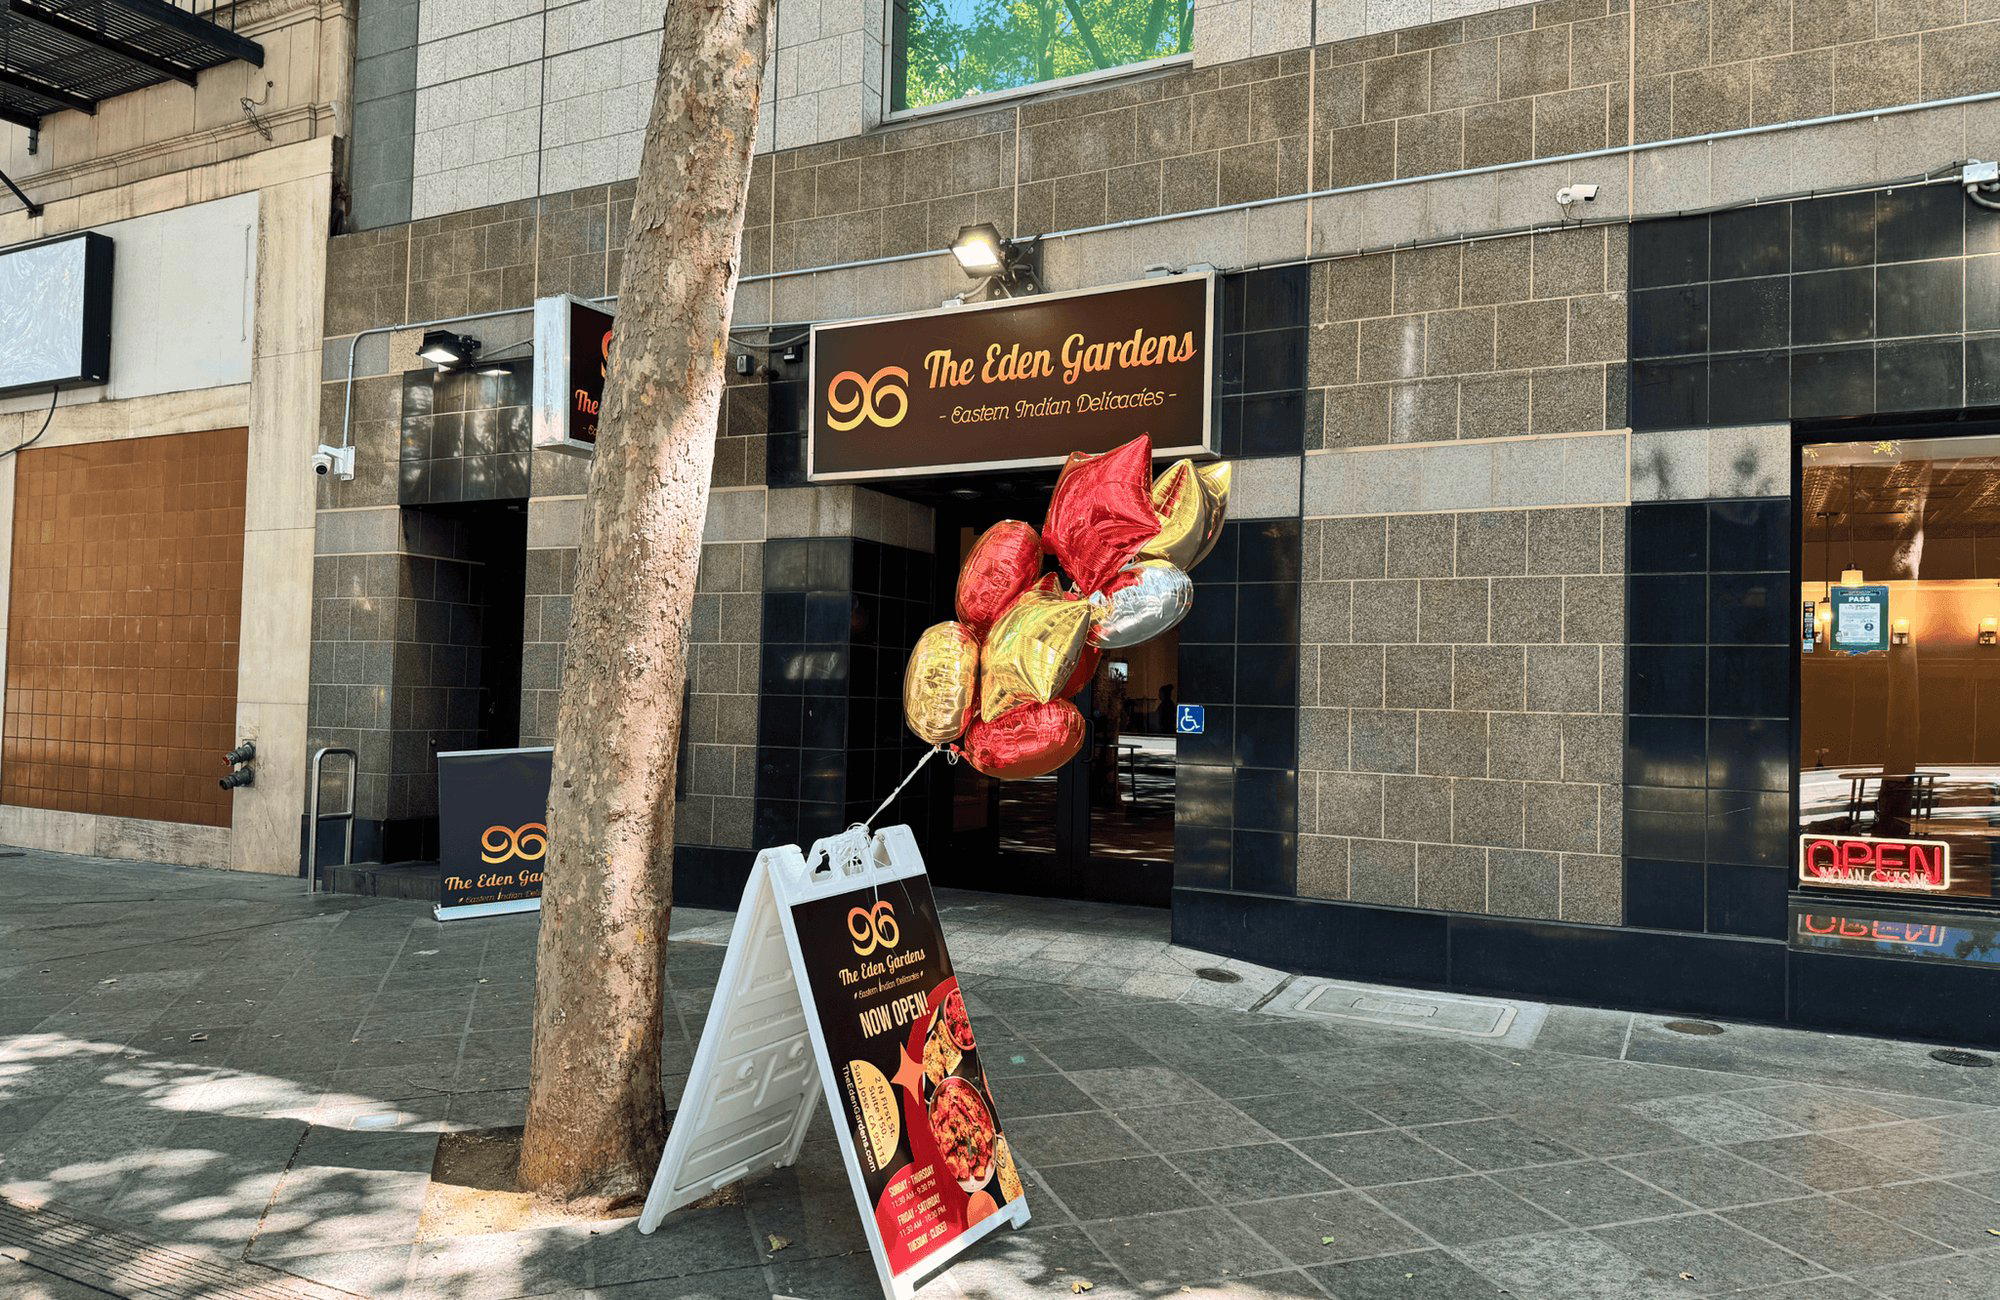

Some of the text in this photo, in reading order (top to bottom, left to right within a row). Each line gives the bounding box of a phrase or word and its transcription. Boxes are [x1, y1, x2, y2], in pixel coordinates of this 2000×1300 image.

[923, 328, 1197, 389] The Eden Gardens
[575, 389, 599, 415] The
[827, 365, 909, 432] 96
[951, 387, 1164, 425] Eastern Indian Delicacies
[481, 822, 548, 864] 96
[1807, 839, 1941, 885] OPEN
[444, 876, 473, 891] The
[477, 873, 515, 888] Eden
[847, 900, 900, 956] 96
[838, 948, 926, 986] The Eden Gardens
[859, 990, 931, 1039] NOW OPEN!
[853, 1064, 863, 1085] San
[867, 1114, 877, 1131] CA
[868, 1085, 880, 1113] Suite
[874, 1076, 882, 1084] 2
[877, 1085, 885, 1095] N
[842, 1064, 877, 1173] TheEdenGardens.com
[880, 1096, 892, 1121] First
[927, 1178, 937, 1189] PM
